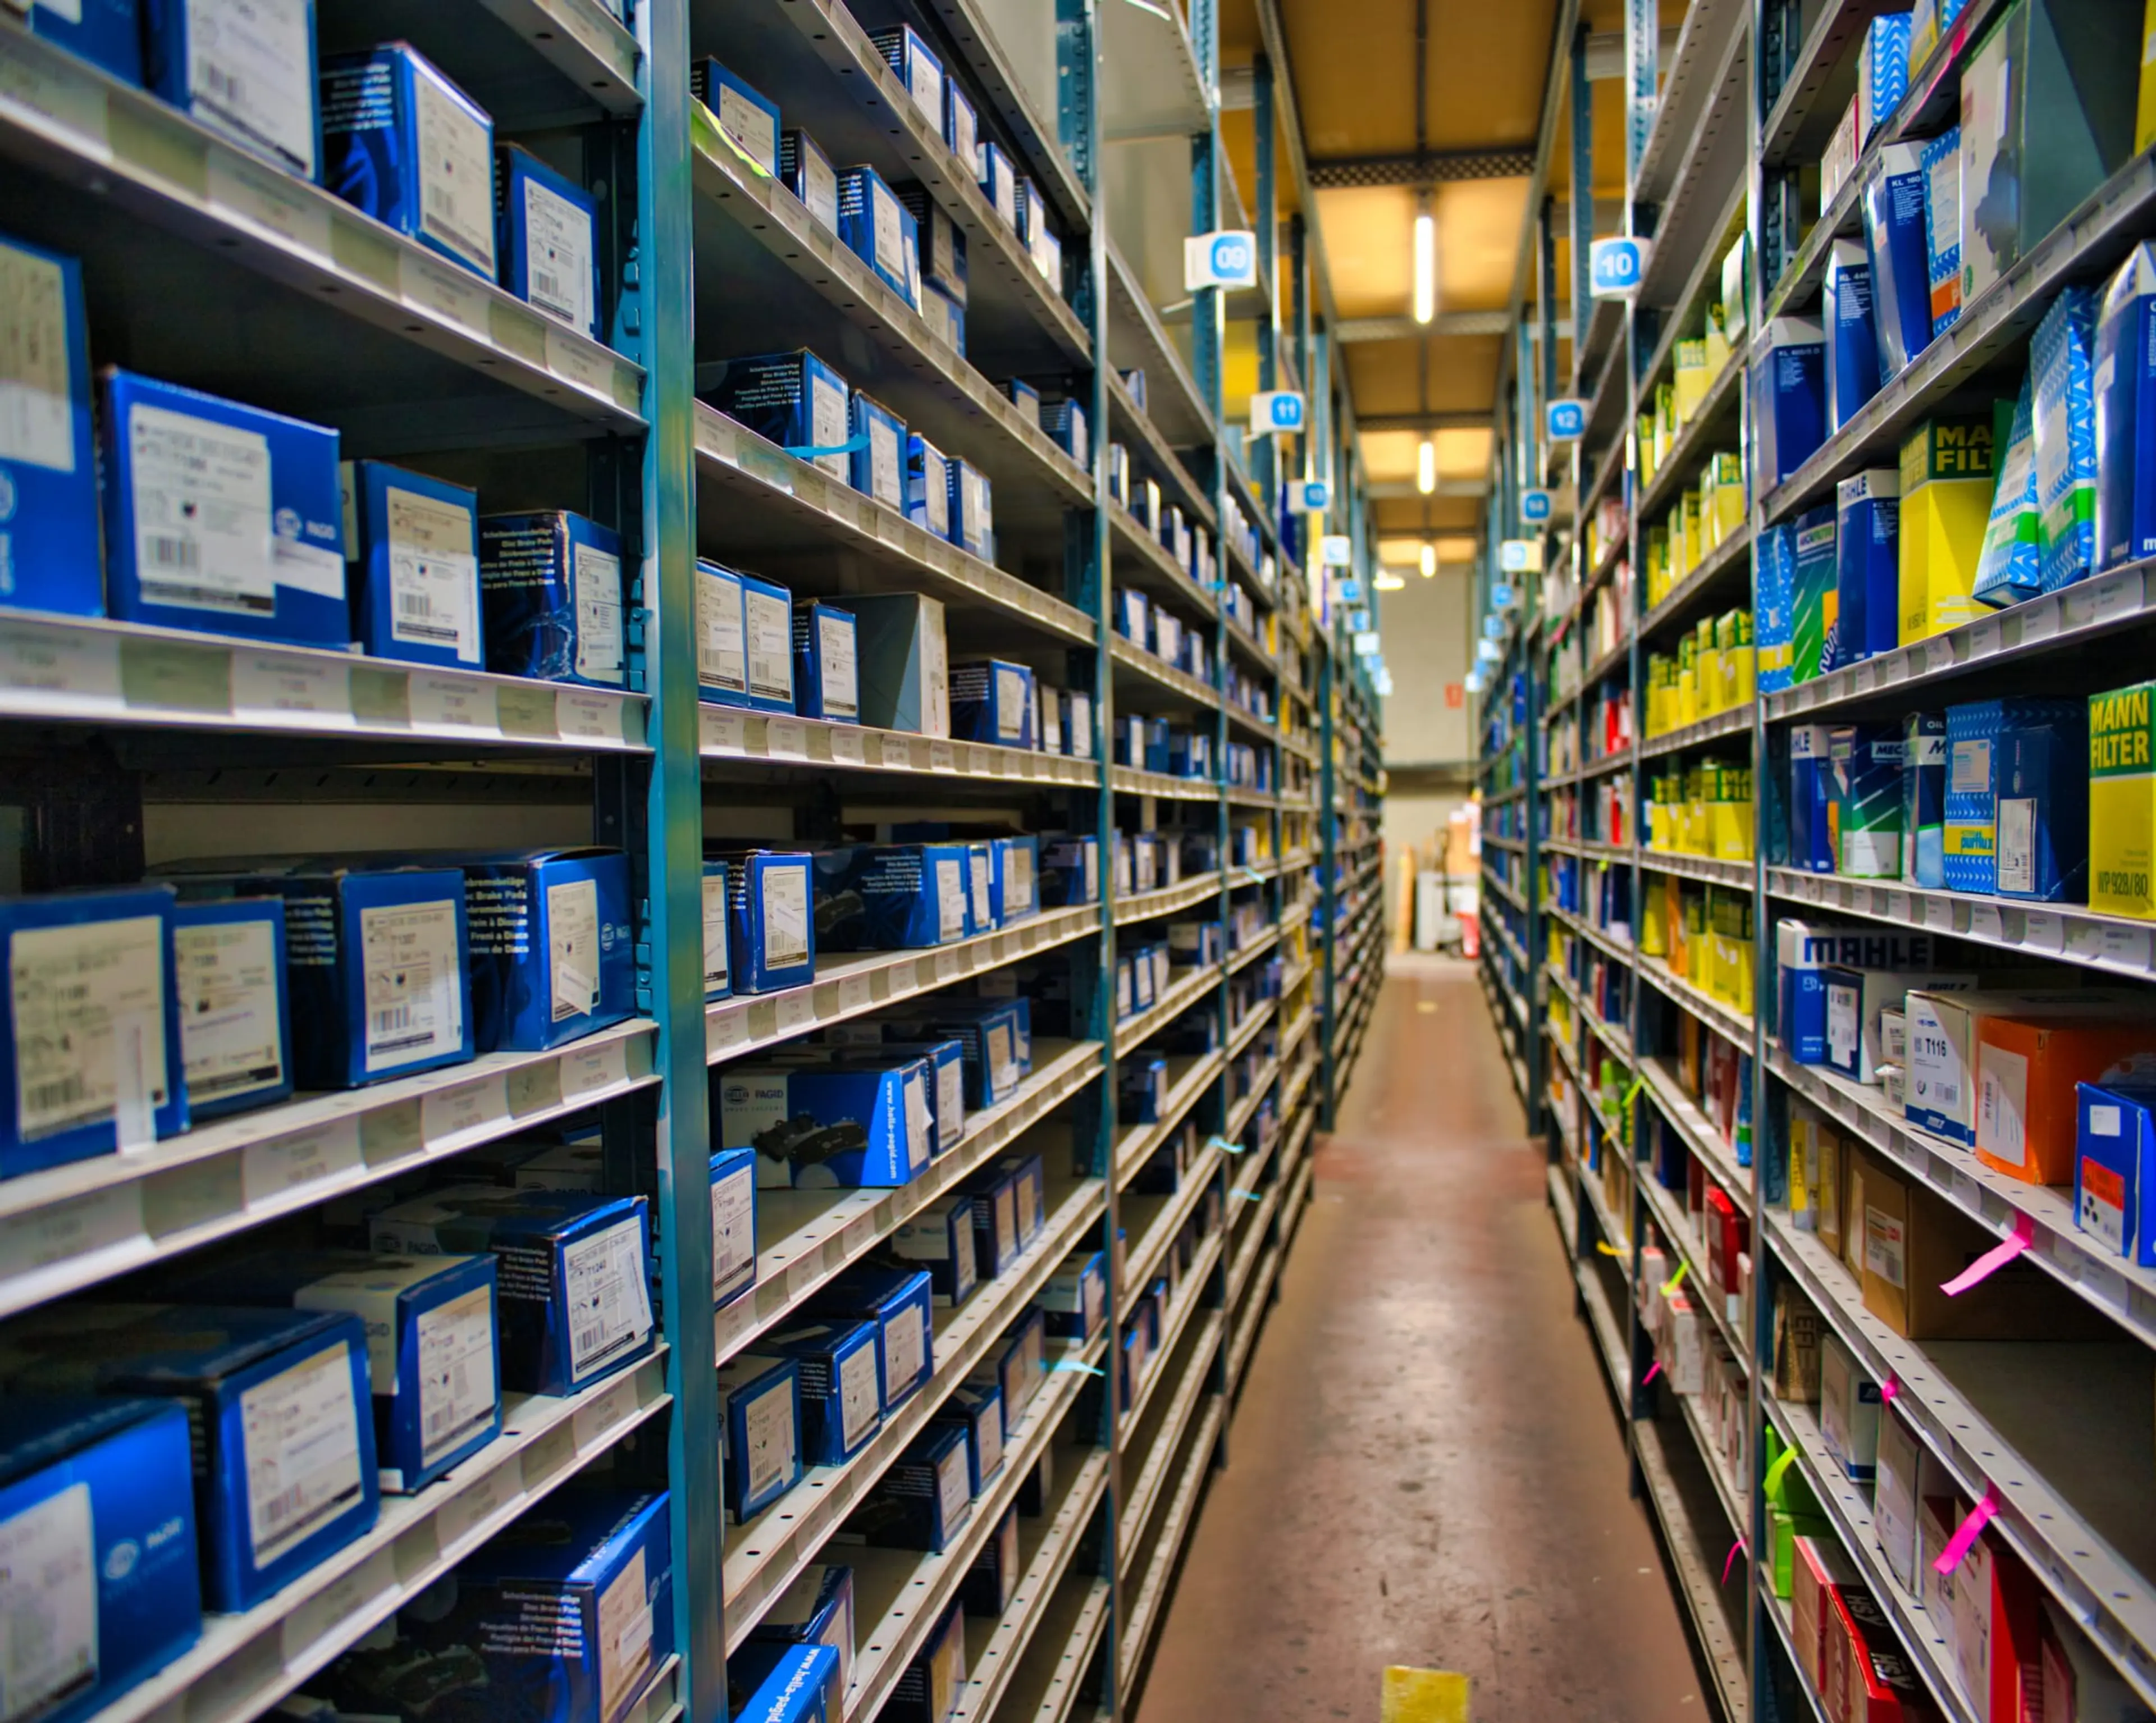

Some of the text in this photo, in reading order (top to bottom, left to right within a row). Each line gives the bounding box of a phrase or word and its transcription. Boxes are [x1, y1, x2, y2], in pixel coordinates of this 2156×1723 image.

[1215, 246, 1248, 269] 09
[1602, 253, 1633, 277] 10
[1556, 411, 1578, 429] 12
[2090, 691, 2149, 734] MANN
[2090, 730, 2149, 769] FILTER
[1804, 936, 1928, 967] MAHLE
[1925, 1038, 1947, 1057] T116
[755, 1089, 784, 1100] PAGID
